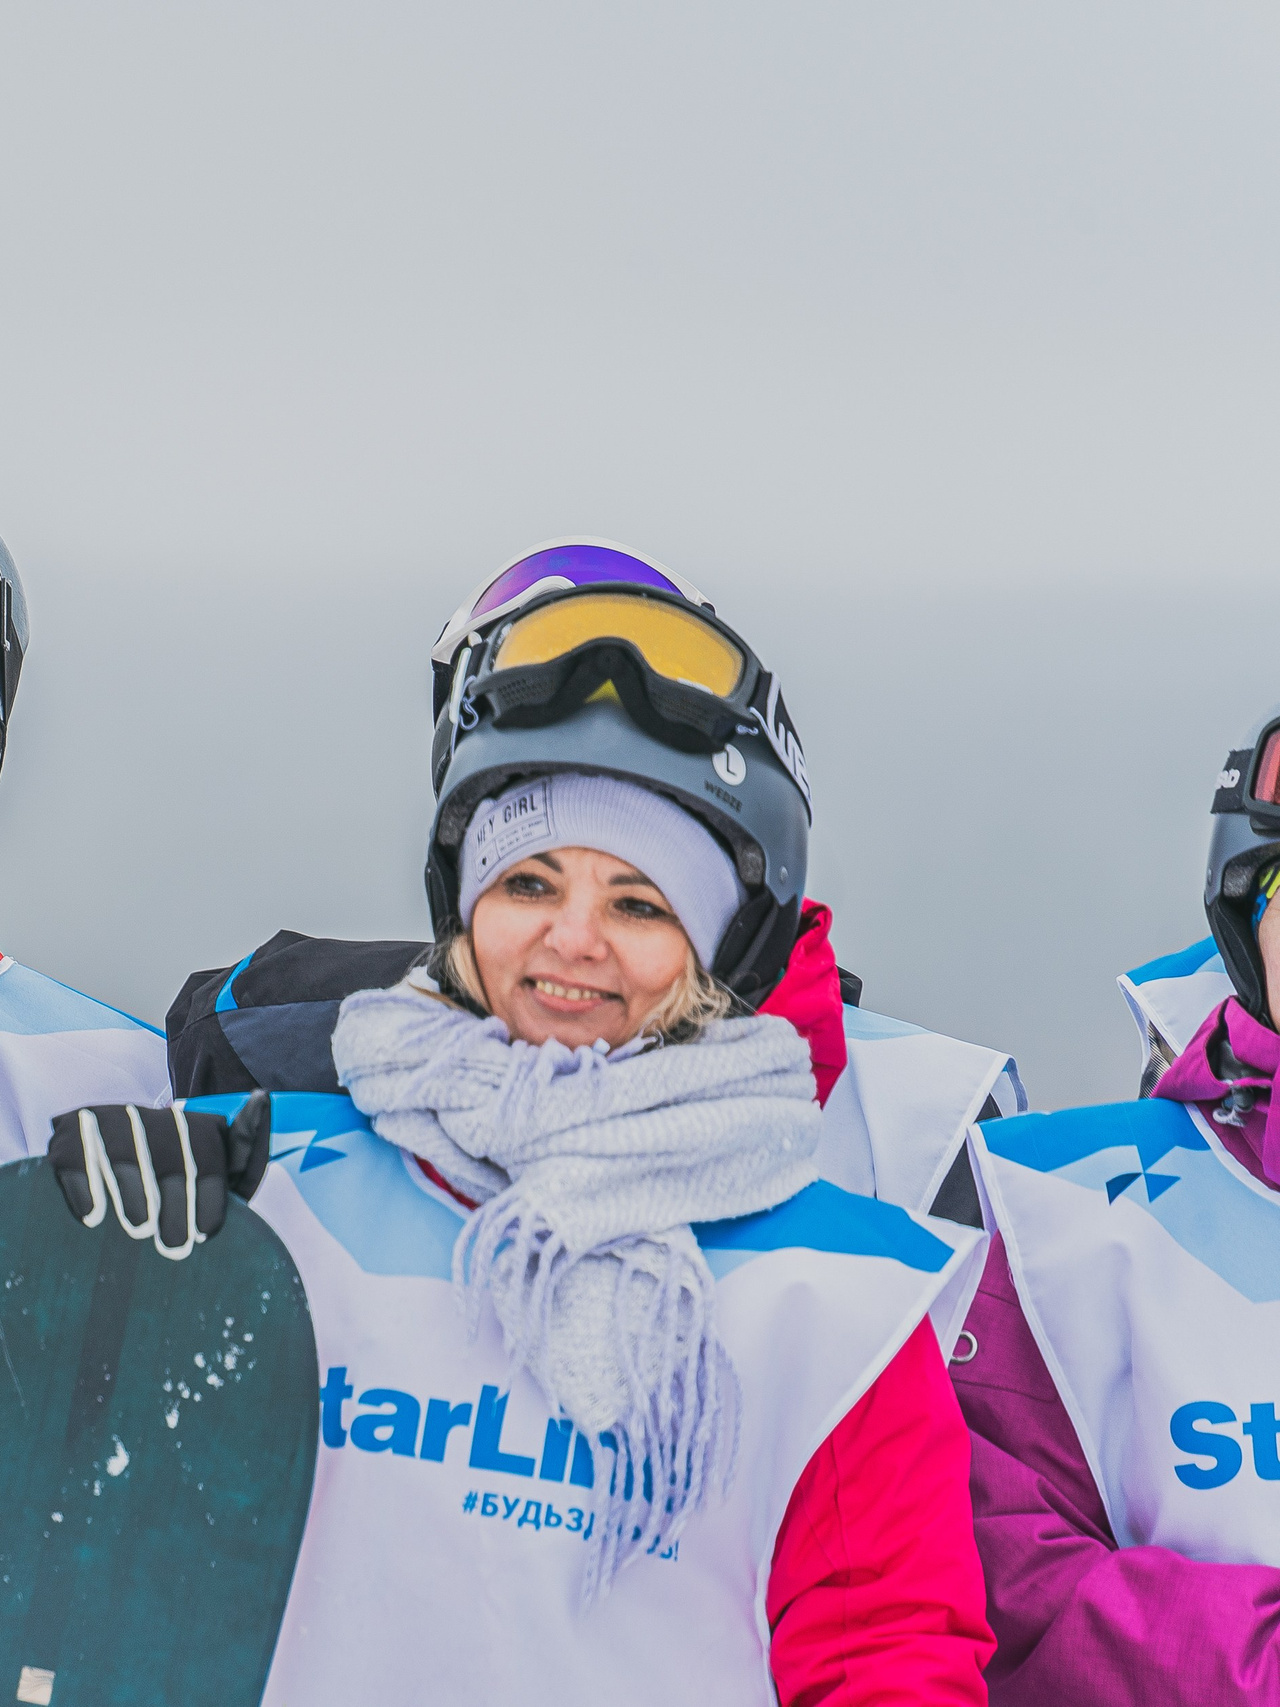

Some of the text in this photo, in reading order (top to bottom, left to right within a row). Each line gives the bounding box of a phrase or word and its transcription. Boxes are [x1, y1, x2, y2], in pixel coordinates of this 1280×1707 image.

[504, 794, 537, 823] GIRL
[320, 1366, 692, 1513] tarLin
[1170, 1401, 1280, 1490] St
